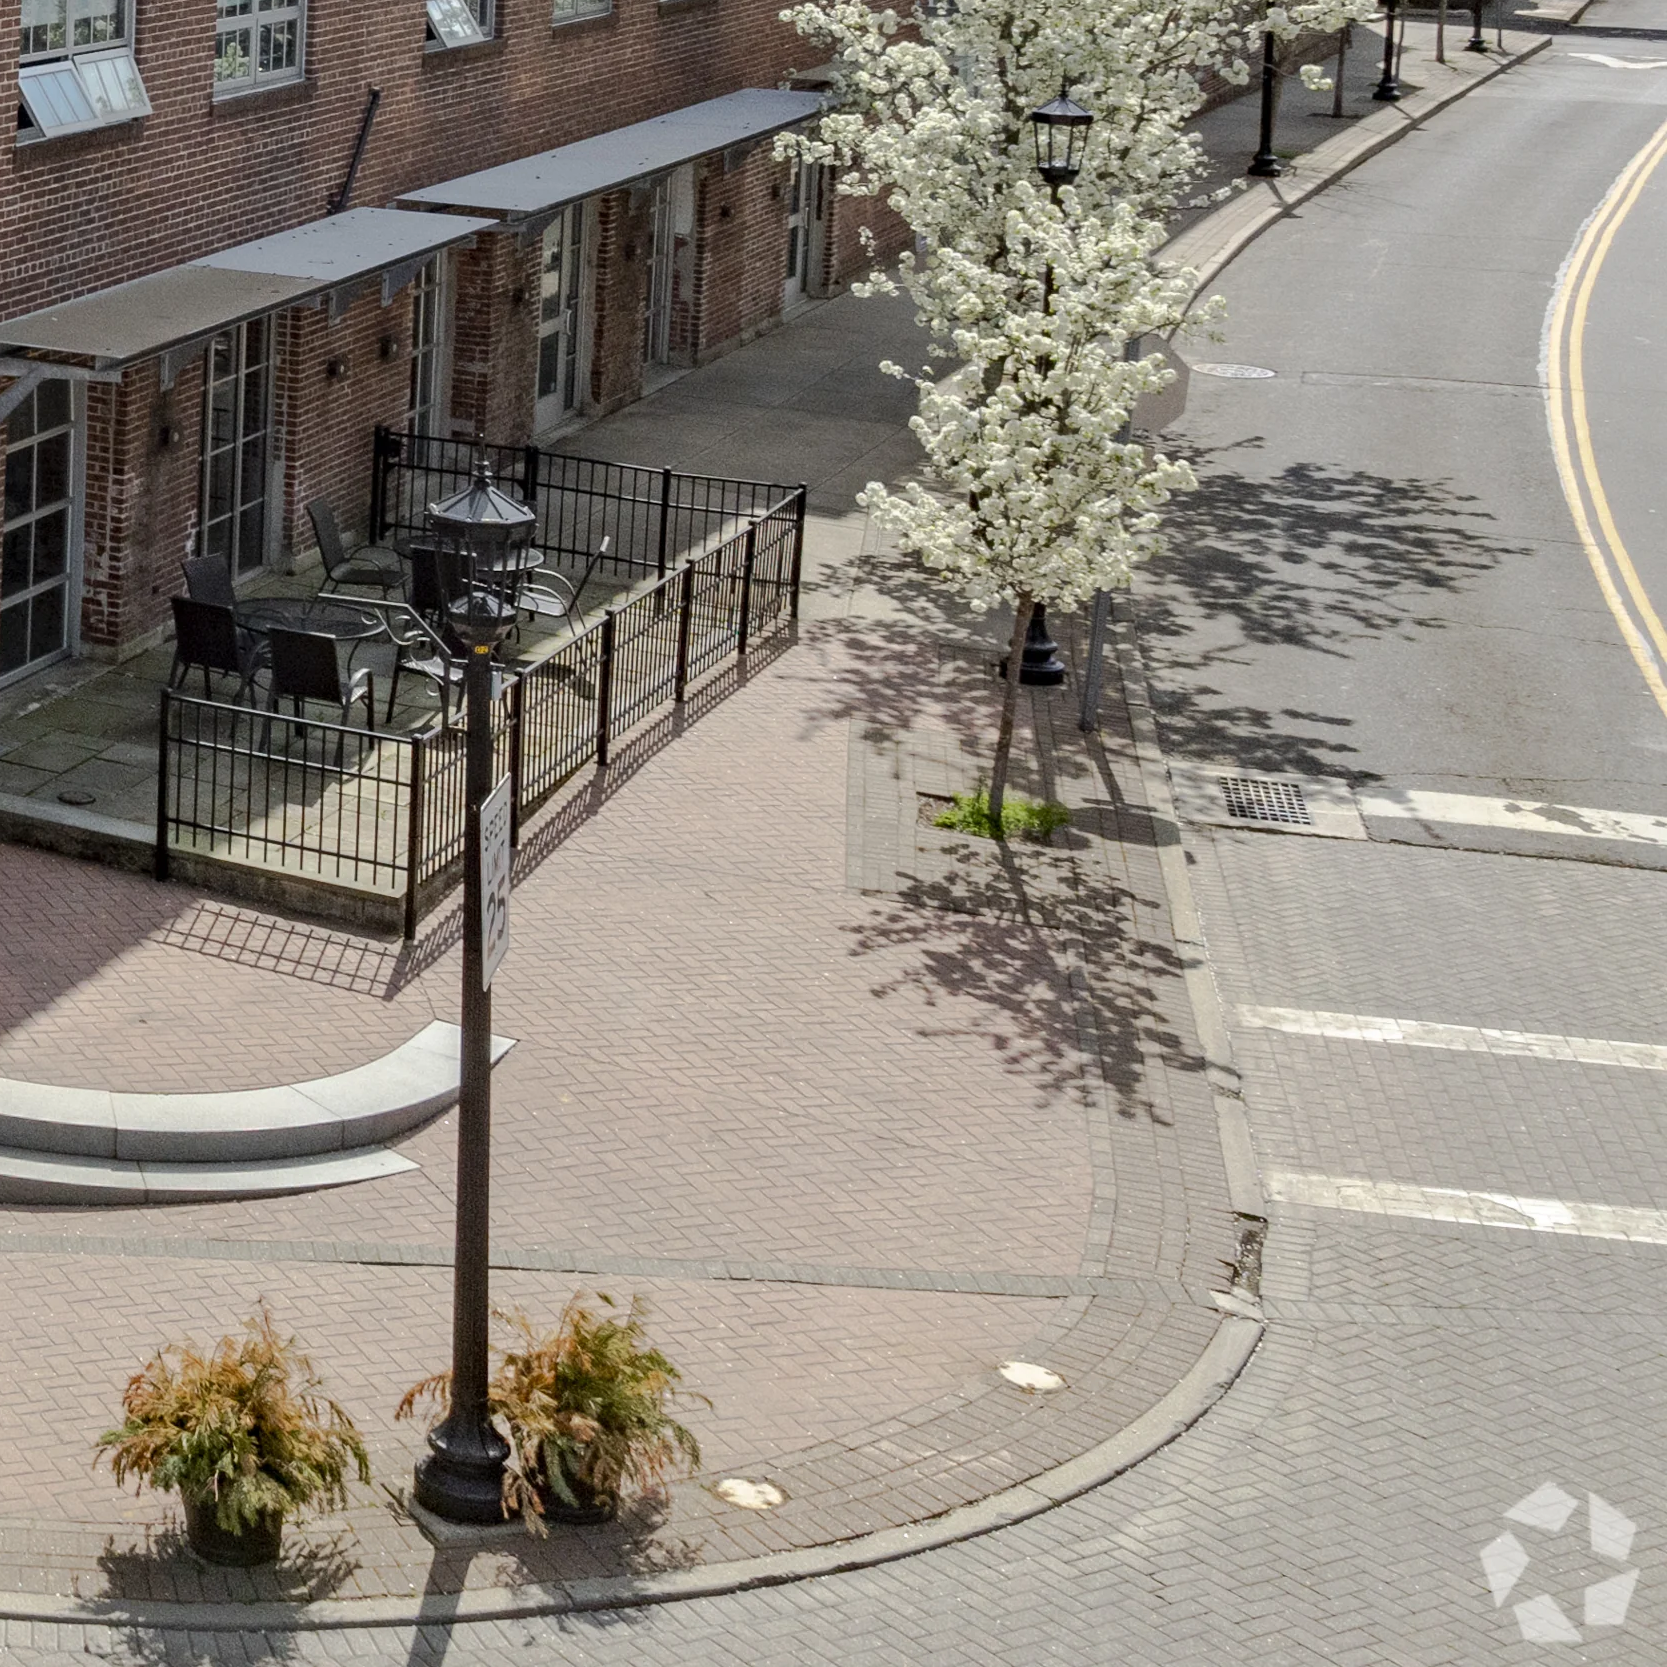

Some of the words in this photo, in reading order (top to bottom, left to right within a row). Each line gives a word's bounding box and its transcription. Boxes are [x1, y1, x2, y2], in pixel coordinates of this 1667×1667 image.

[484, 801, 508, 853] SPEED
[487, 839, 505, 886] LIMIT
[486, 874, 507, 962] 25
